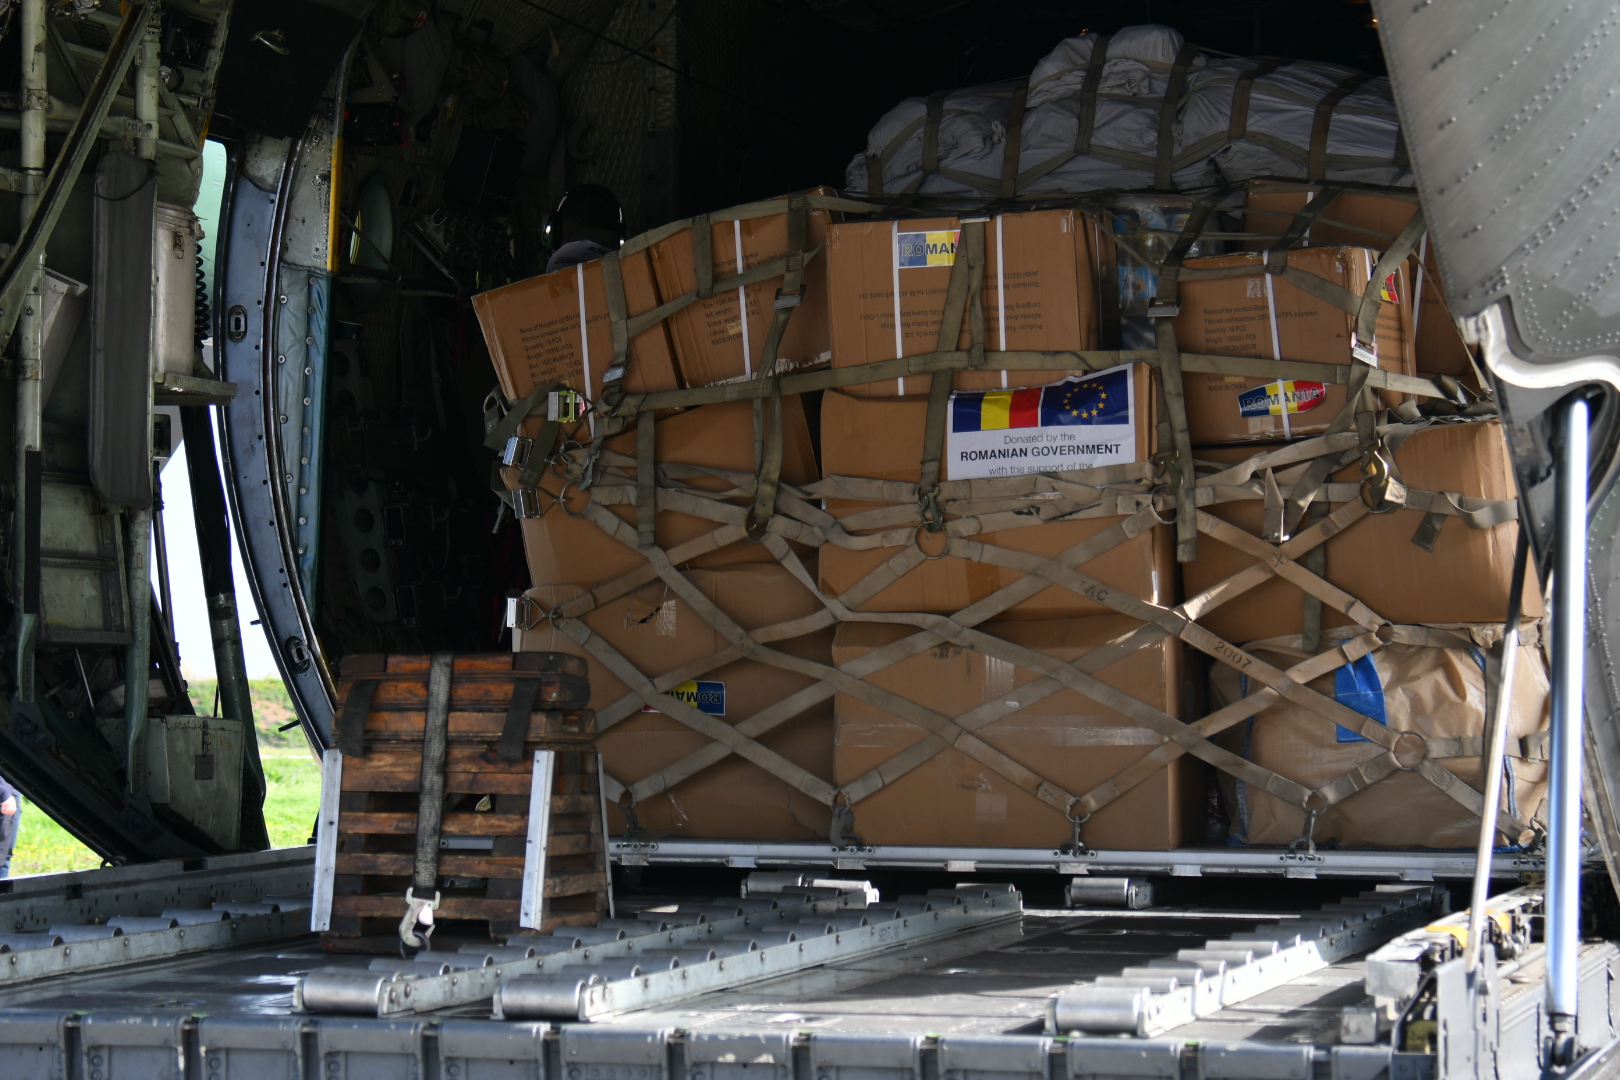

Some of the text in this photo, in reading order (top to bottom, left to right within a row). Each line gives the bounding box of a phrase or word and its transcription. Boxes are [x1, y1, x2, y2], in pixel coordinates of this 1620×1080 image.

[1233, 305, 1253, 314] product
[1294, 310, 1318, 319] polyester
[1205, 337, 1223, 345] Weight
[1004, 432, 1076, 445] Donated by the
[960, 442, 1122, 462] ROMANIAN GOVERNMENT
[988, 461, 1094, 476] with the support of the
[1214, 641, 1253, 669] 2007
